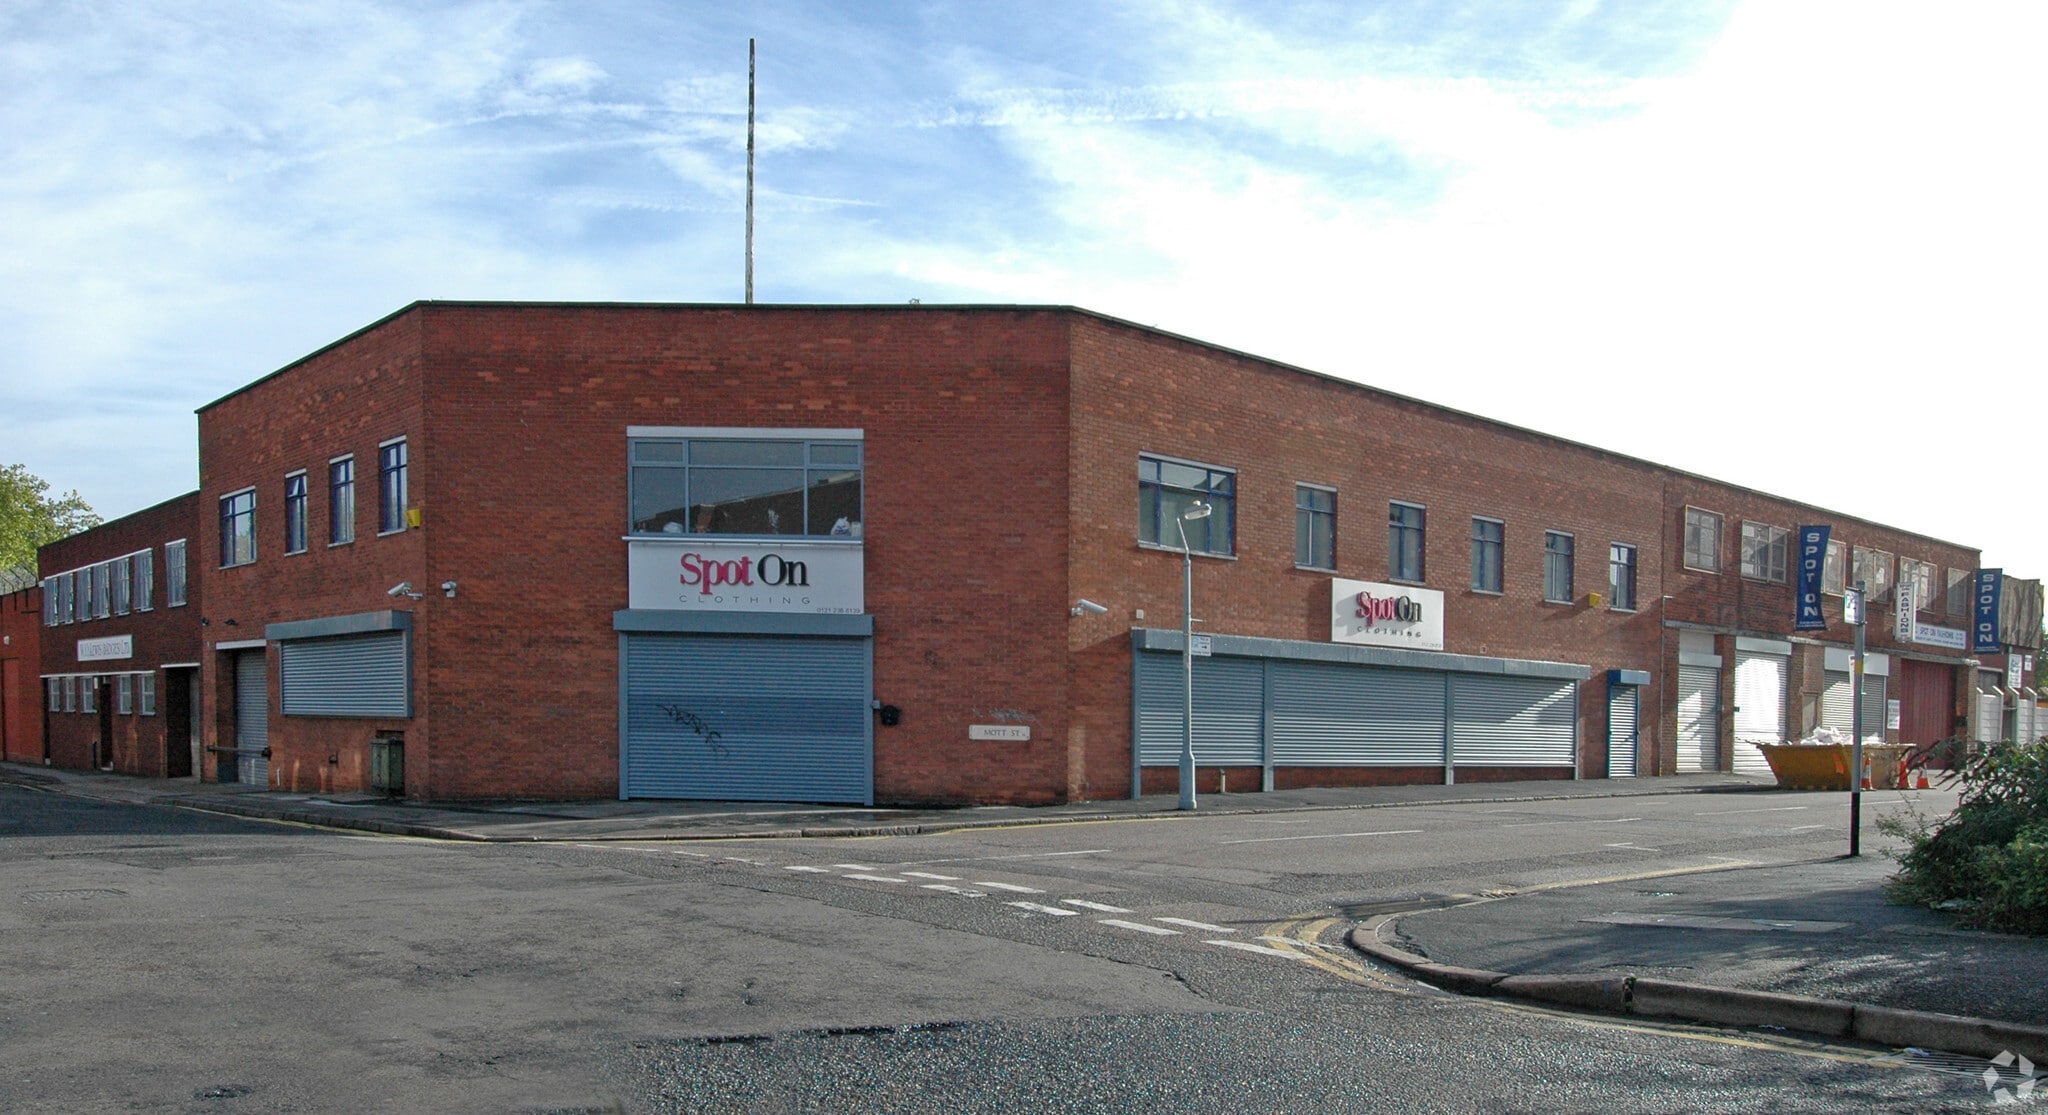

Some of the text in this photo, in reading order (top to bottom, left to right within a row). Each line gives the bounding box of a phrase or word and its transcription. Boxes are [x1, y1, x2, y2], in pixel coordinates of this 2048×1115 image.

[1805, 533, 1820, 583] SPOT
[680, 553, 810, 595] Spot On
[679, 595, 811, 605] CLOTHING
[1355, 591, 1422, 627] Spot On
[1804, 594, 1818, 617] ON
[1980, 574, 1994, 615] SPOT
[1900, 592, 1909, 633] FASHIONS
[1357, 626, 1421, 638] CLOTHING
[1979, 623, 1993, 643] ON
[984, 729, 1006, 737] MOTT
